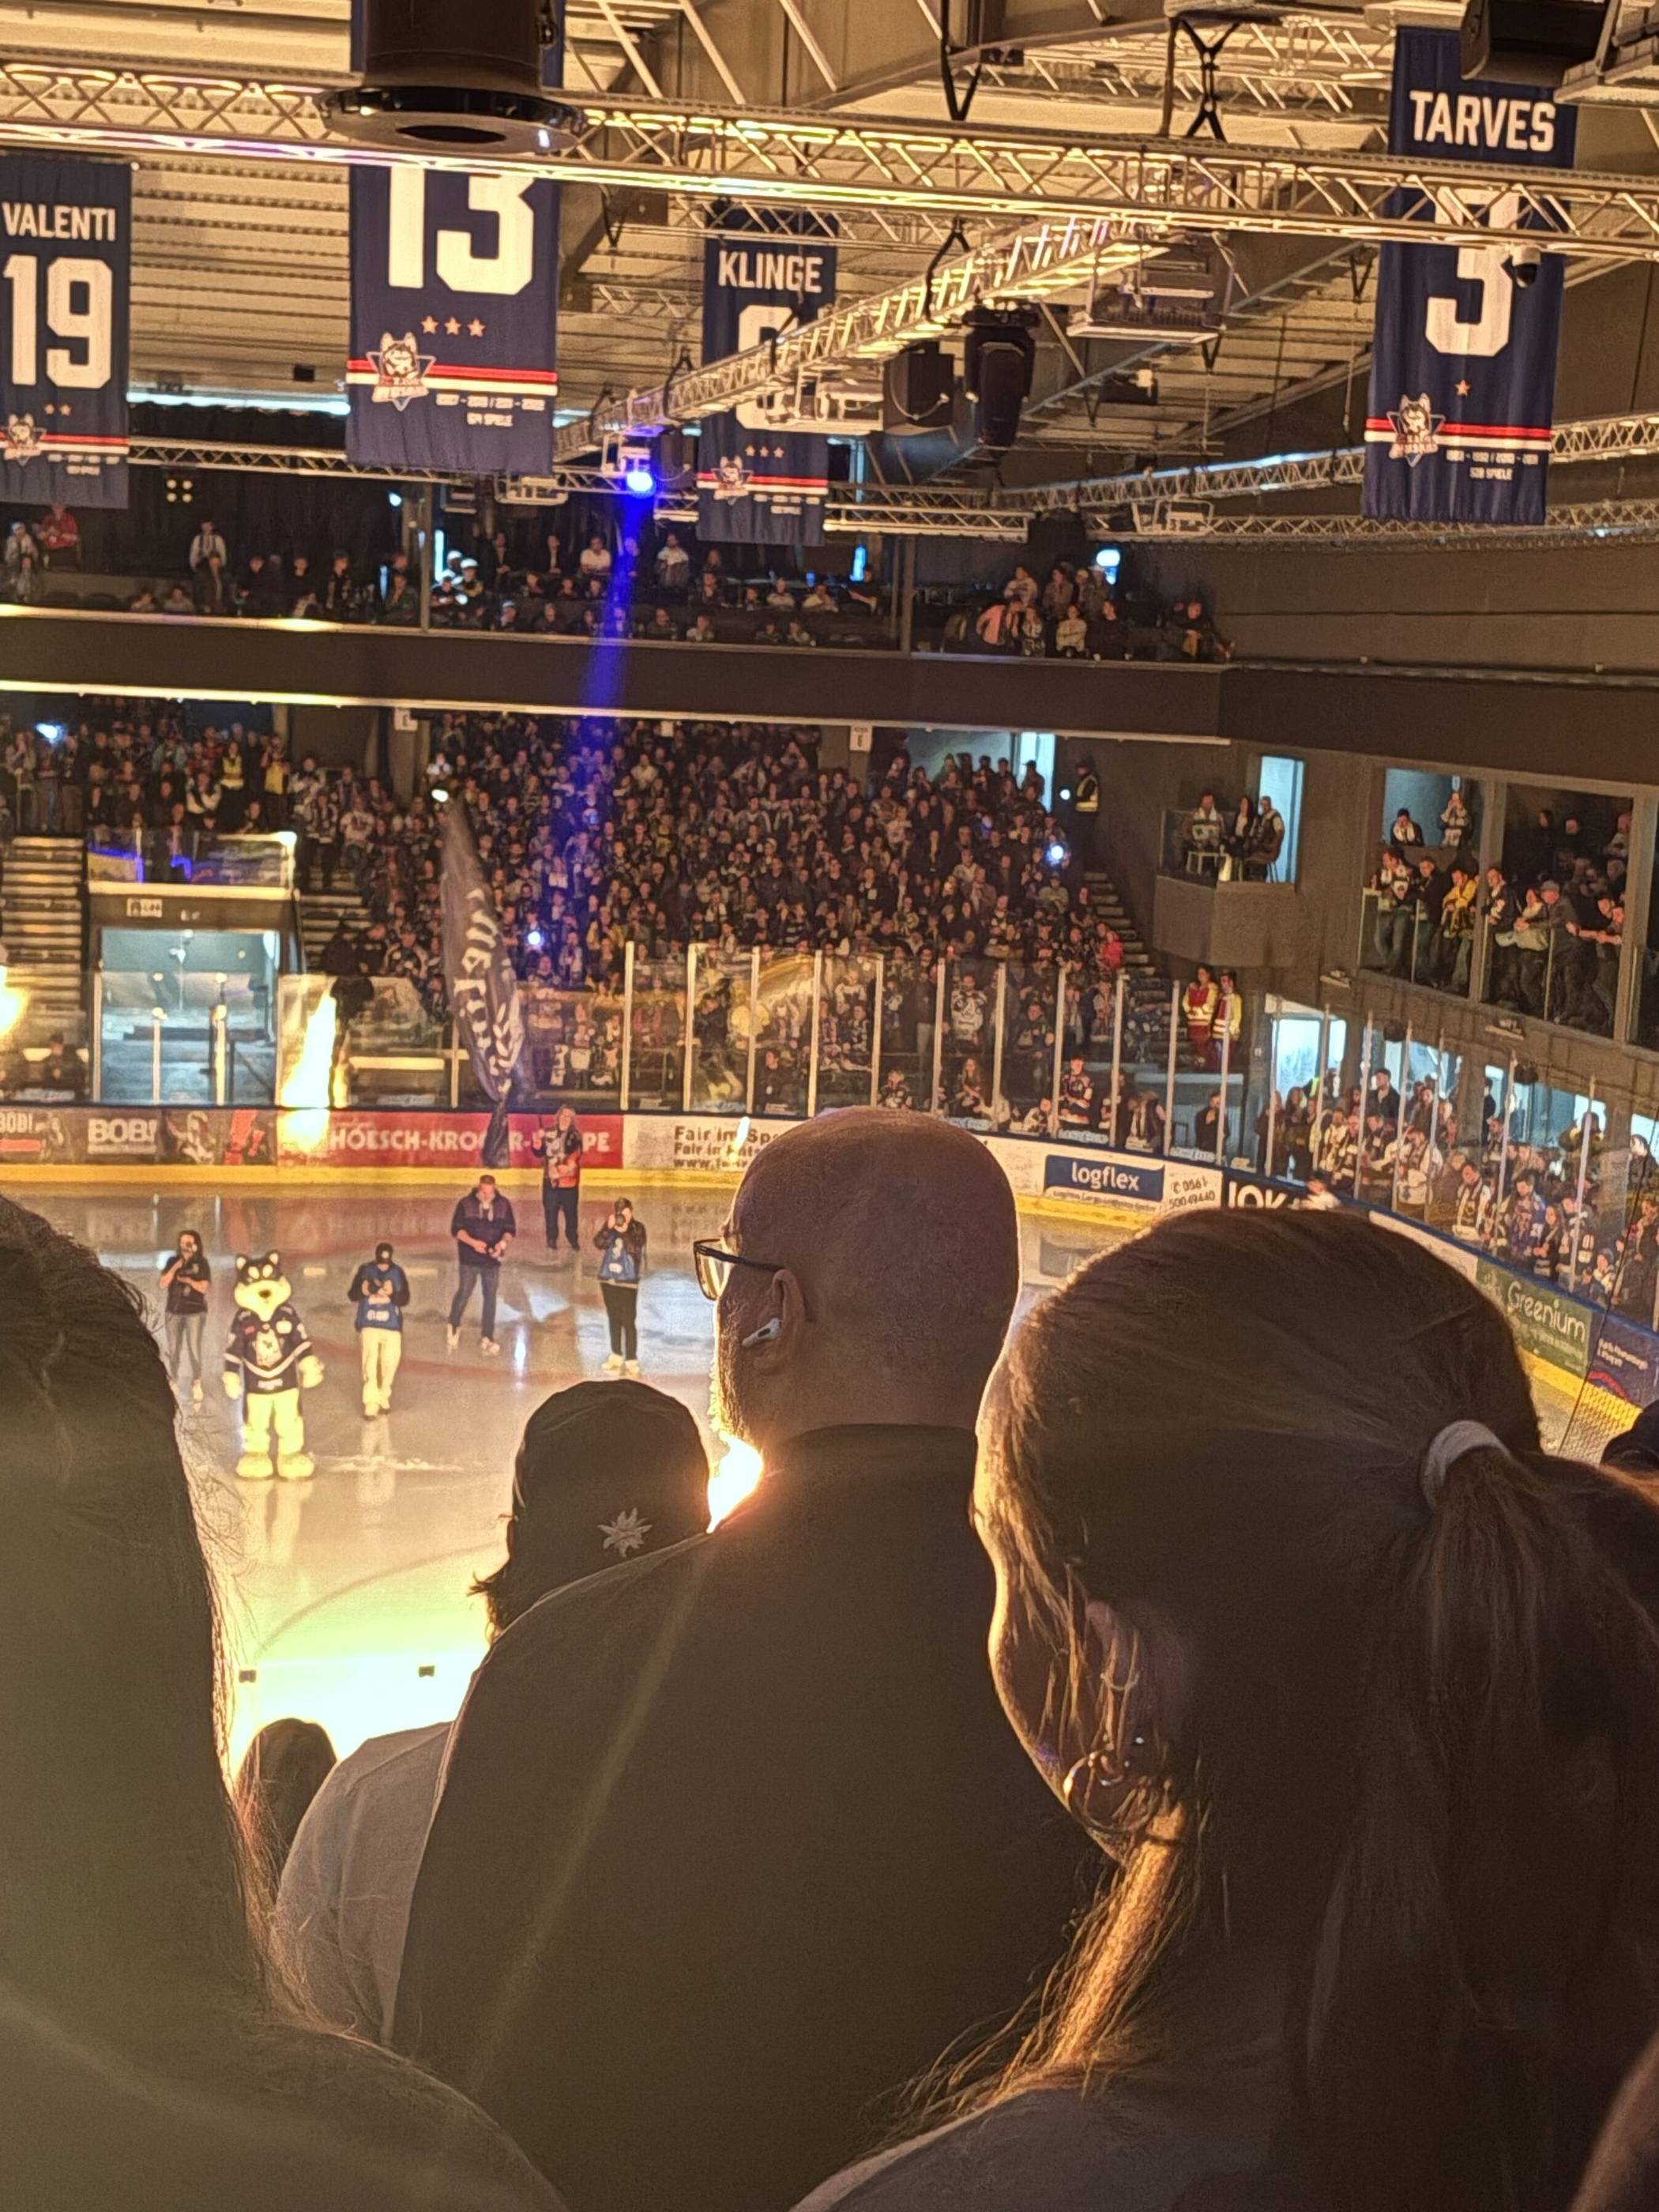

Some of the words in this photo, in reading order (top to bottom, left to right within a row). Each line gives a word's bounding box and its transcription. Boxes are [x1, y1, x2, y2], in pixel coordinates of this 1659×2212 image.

[1409, 90, 1556, 152] TARVES
[2, 201, 115, 242] VALENTI
[389, 166, 534, 295] 13
[718, 250, 823, 294] KLINGE
[3, 254, 113, 389] 19
[88, 1118, 158, 1142] BOB!
[674, 1126, 711, 1141] Fair
[674, 1142, 702, 1155] Fair
[1071, 1161, 1140, 1191] logflex
[1507, 1281, 1585, 1343] Greenium
